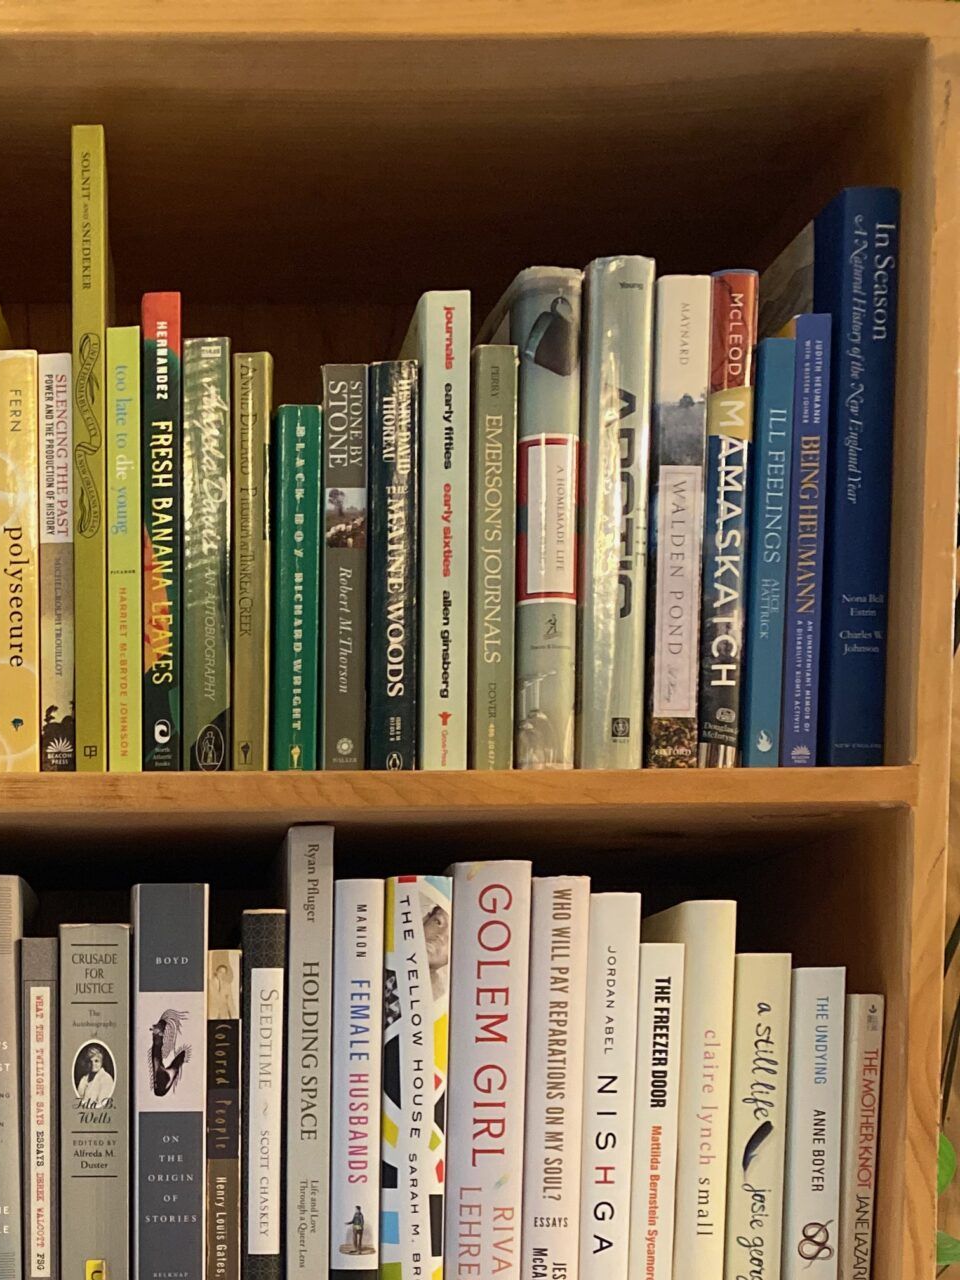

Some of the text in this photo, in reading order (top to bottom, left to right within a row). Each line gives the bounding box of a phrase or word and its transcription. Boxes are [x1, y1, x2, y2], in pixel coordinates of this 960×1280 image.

[81, 152, 90, 199] SOLNIT
[151, 321, 174, 684] HERNANDEZ FRESH BANANA LEAVES
[711, 401, 744, 686] MAMASKATCH
[4, 527, 30, 667] polysecure
[71, 953, 117, 966] CRUSADE
[155, 956, 189, 965] BOYD
[85, 968, 104, 980] FOR
[75, 983, 113, 995] JUSTICE
[472, 884, 513, 1166] GOLEM GIRL
[650, 976, 671, 1108] THE FREEZER DOOR
[162, 1135, 180, 1144] ON
[159, 1155, 183, 1163] THE
[593, 1075, 617, 1255] NISHGA
[148, 1173, 194, 1182] ORIGIN
[164, 1194, 178, 1202] OF
[145, 1215, 197, 1223] STORIES
[533, 1217, 568, 1228] ESSAYS
